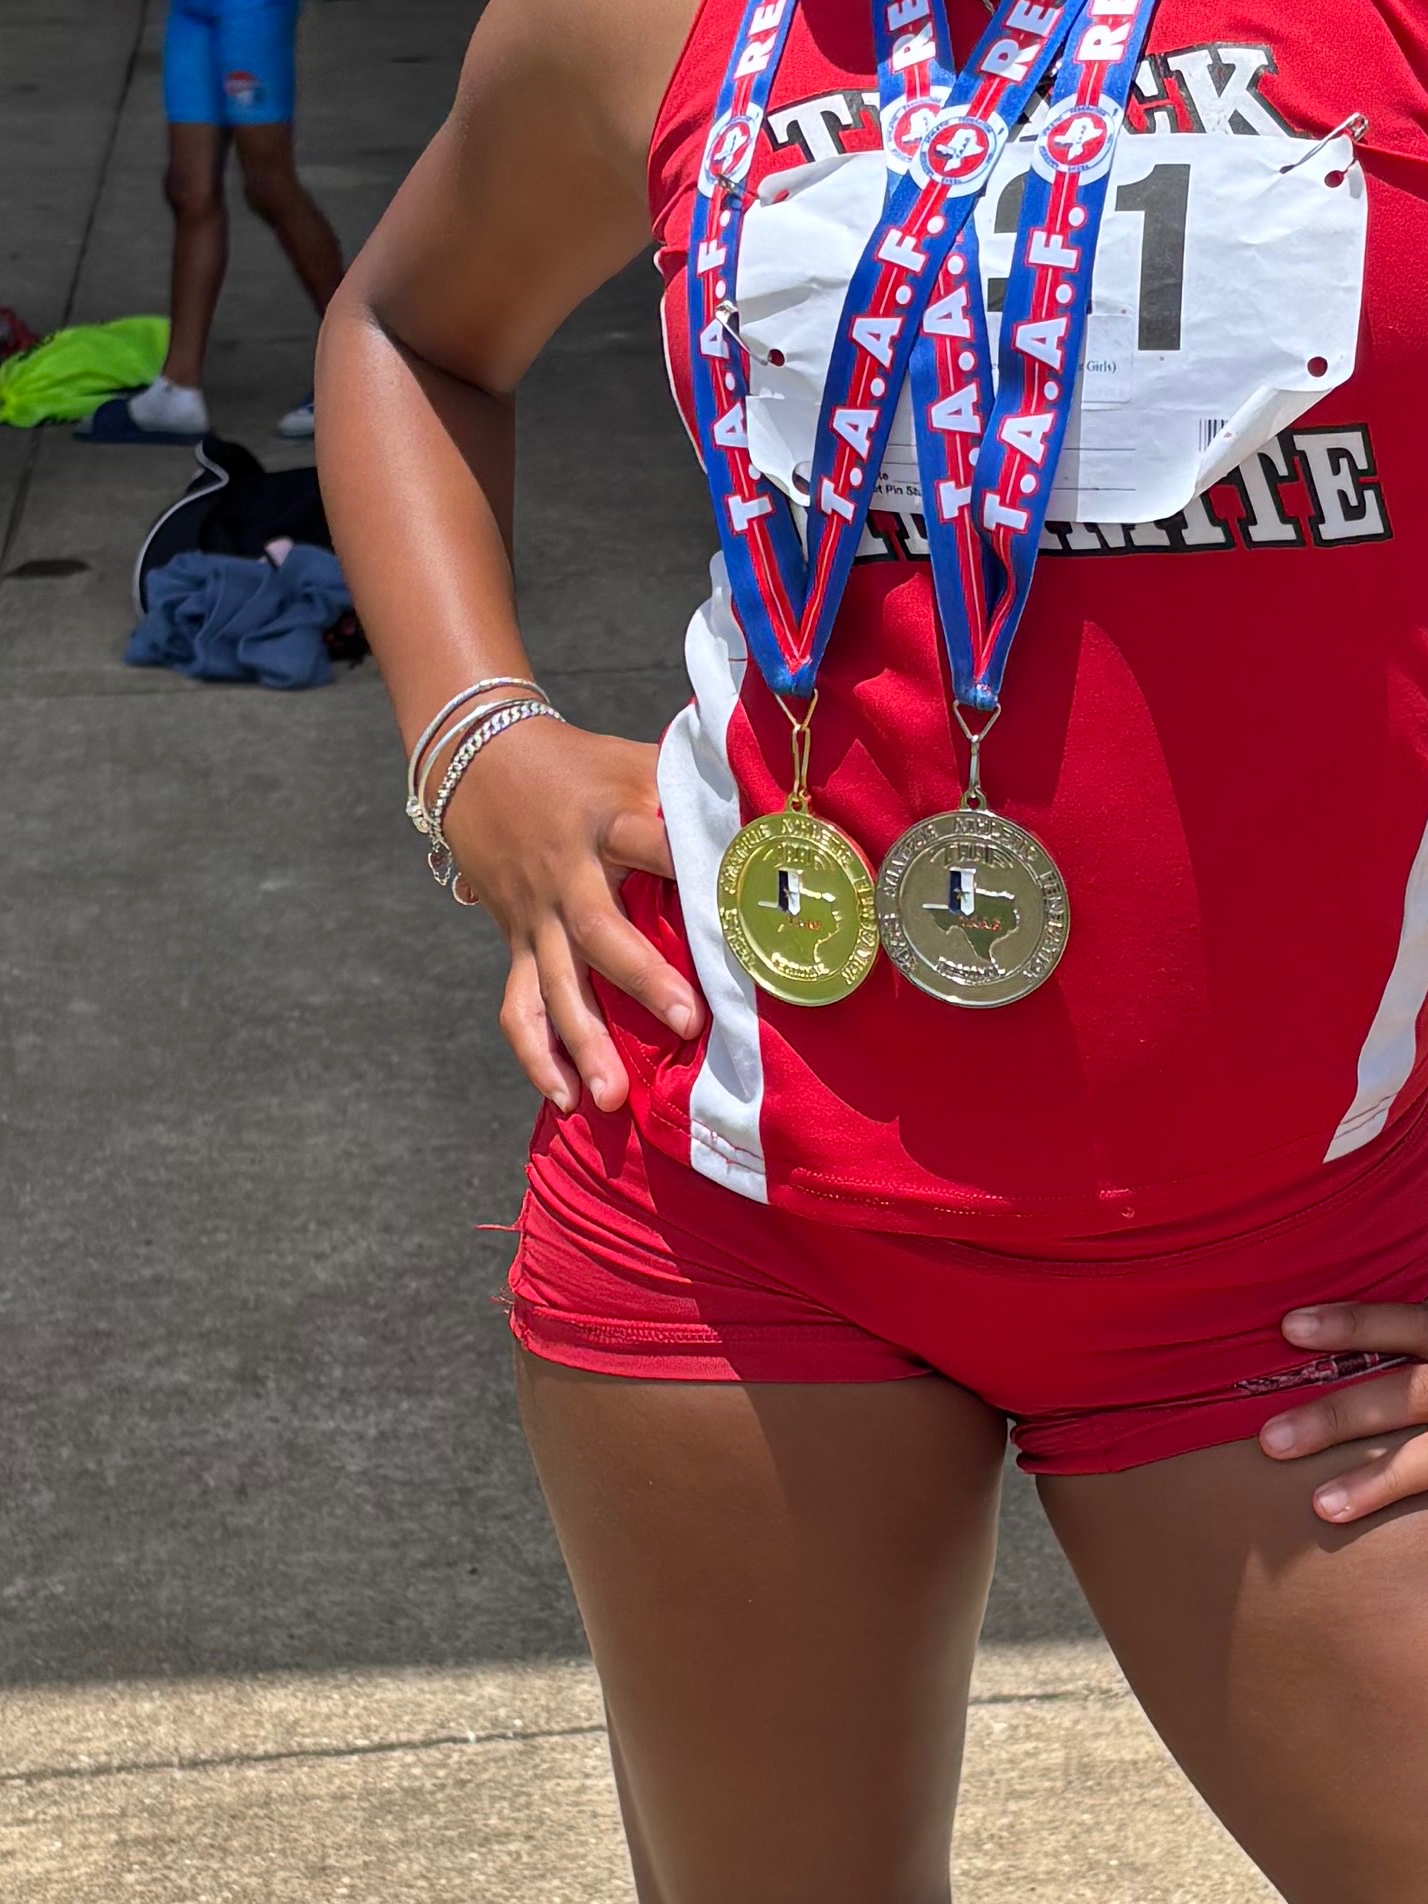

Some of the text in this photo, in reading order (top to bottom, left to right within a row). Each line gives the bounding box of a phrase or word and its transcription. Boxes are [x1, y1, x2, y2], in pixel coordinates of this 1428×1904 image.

[821, 215, 945, 522] T.A.A.F.
[924, 255, 980, 520] T.A.A.
[983, 207, 1086, 531] T.A.A.F.
